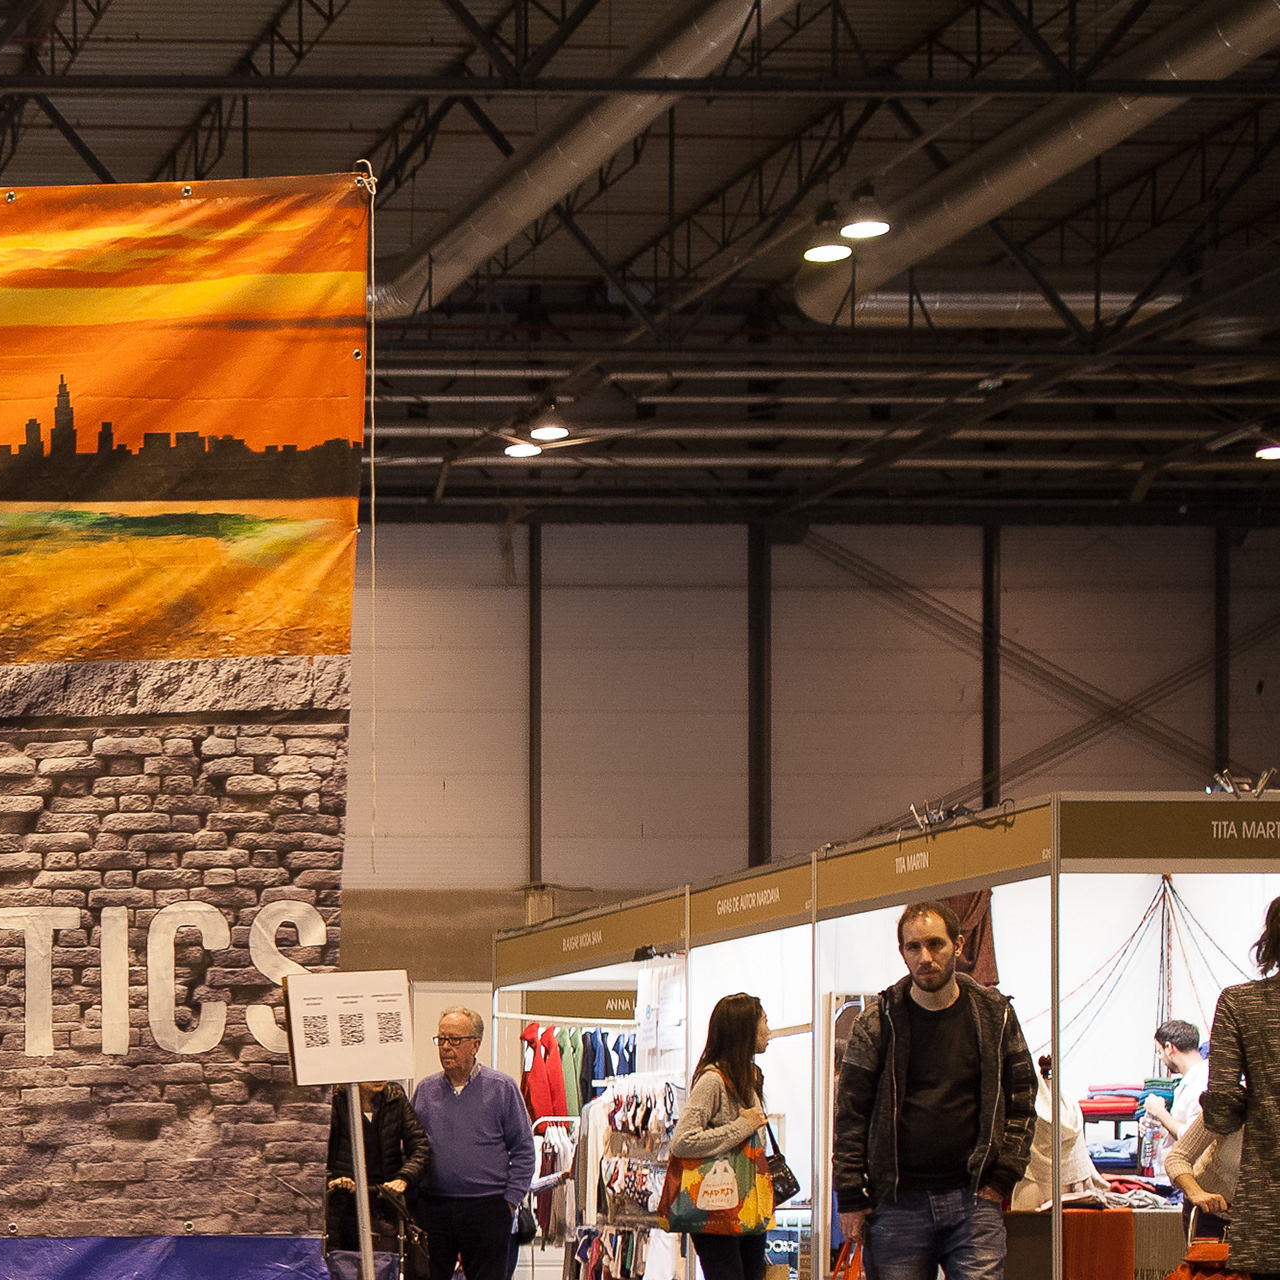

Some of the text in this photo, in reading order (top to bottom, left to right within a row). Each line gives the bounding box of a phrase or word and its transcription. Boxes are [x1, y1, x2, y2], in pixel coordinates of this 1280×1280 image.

[1211, 820, 1238, 839] TITA
[895, 851, 930, 875] TITA MARTIN
[605, 998, 631, 1011] ANNA
